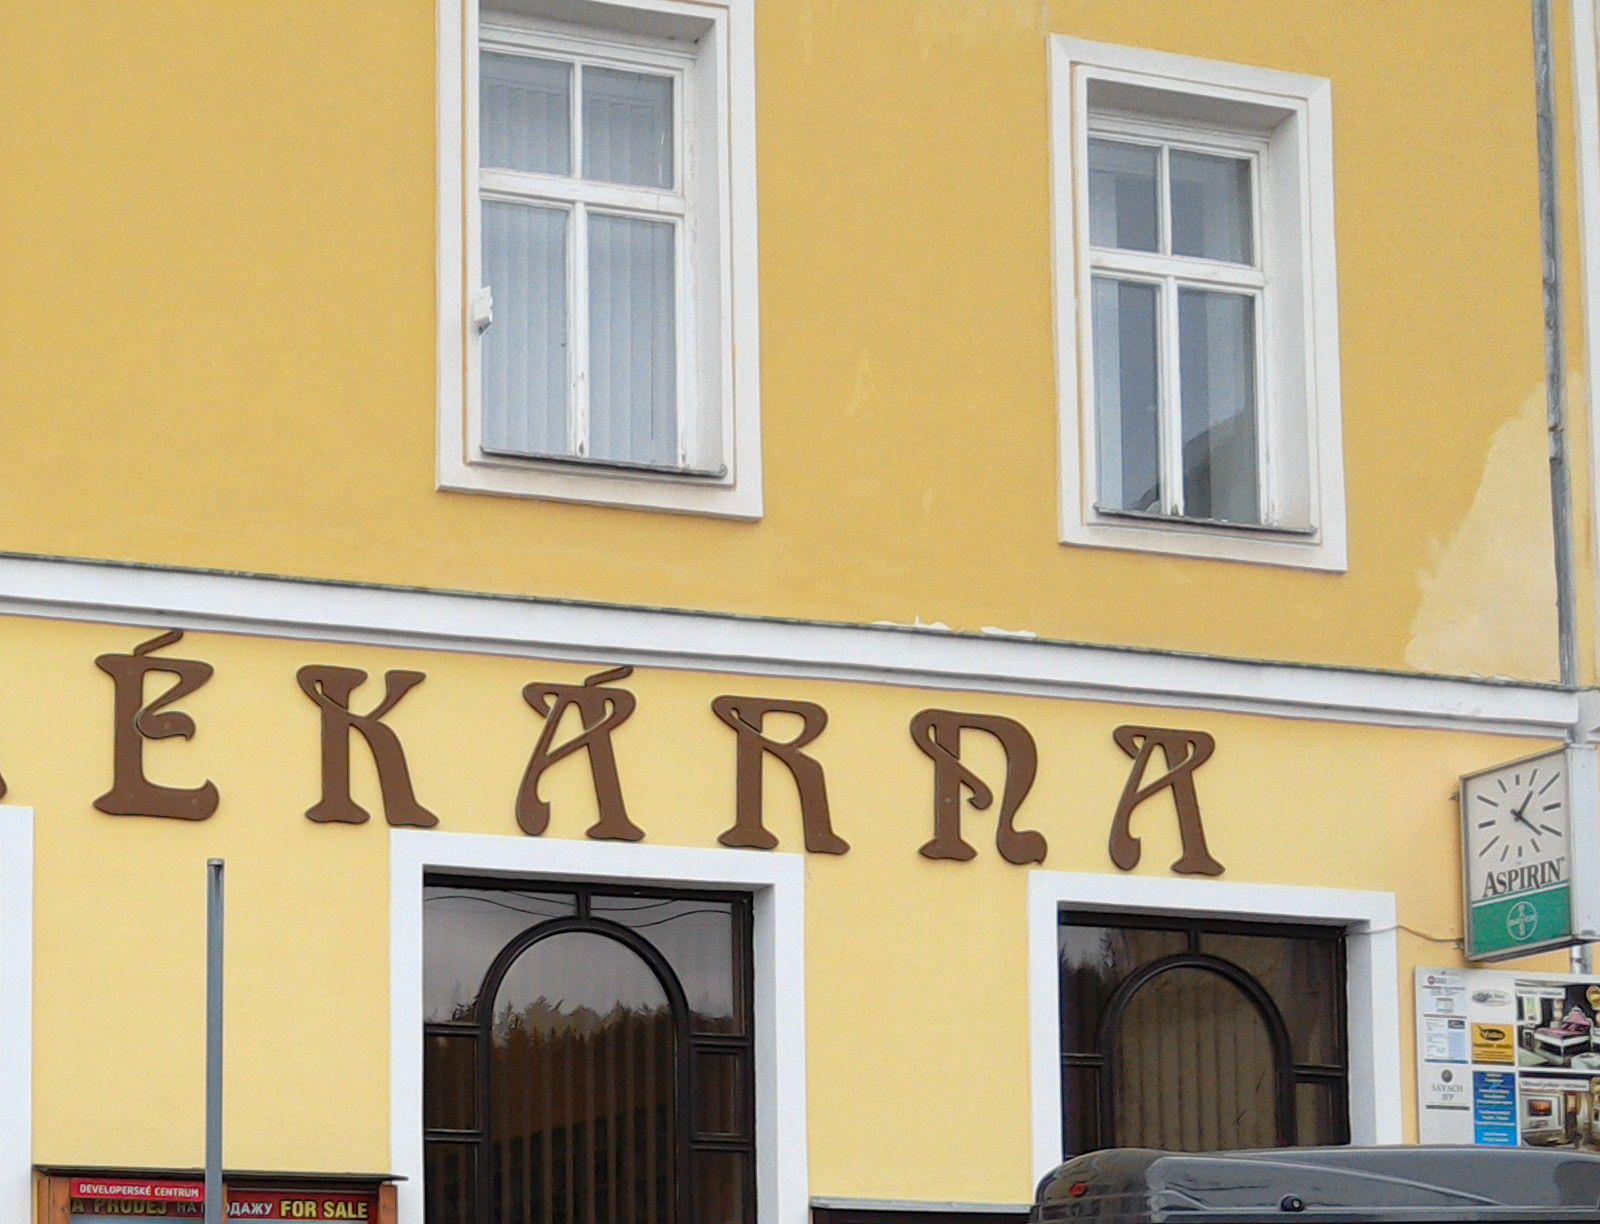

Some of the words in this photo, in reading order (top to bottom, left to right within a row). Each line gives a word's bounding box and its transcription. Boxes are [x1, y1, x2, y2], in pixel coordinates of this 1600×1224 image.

[1482, 858, 1565, 899] ASPIRIN
[79, 1183, 151, 1196] DEVELOPERSKÉ
[154, 1185, 200, 1198] CENTRUM
[280, 1200, 317, 1218] FOR
[323, 1201, 368, 1219] SALE
